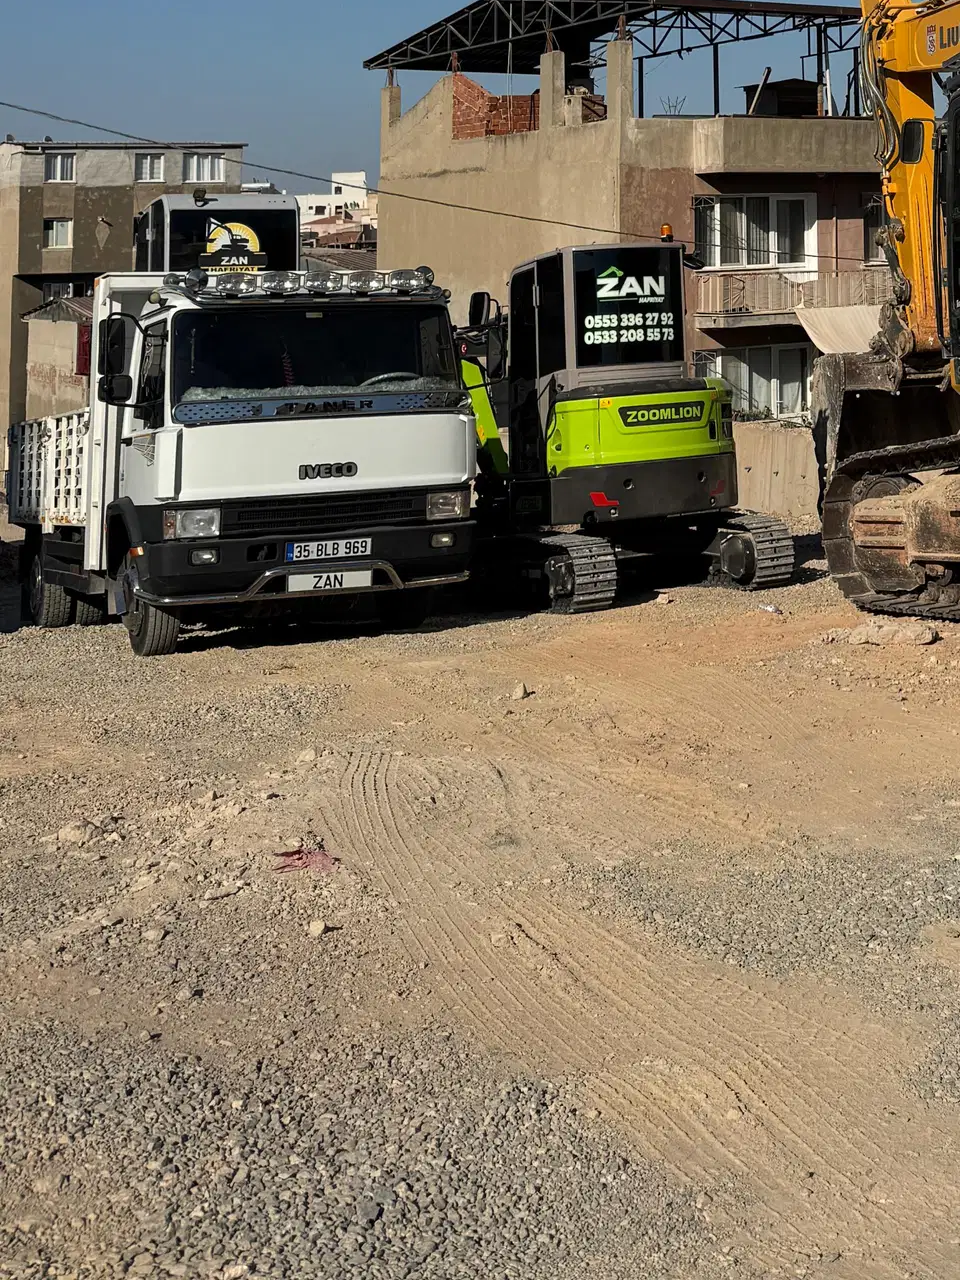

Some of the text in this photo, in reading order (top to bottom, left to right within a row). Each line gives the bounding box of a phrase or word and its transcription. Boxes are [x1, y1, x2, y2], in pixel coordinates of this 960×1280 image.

[221, 256, 248, 265] ZAN
[596, 276, 665, 298] ZAN
[584, 312, 674, 329] 0553 336 27 92
[584, 328, 674, 345] 0533 208 55 73
[626, 405, 701, 423] ZOOMLION
[299, 462, 358, 480] IVECO
[295, 545, 310, 558] 35
[316, 542, 339, 557] BLB
[344, 540, 367, 554] 969
[313, 574, 343, 589] ZAN
